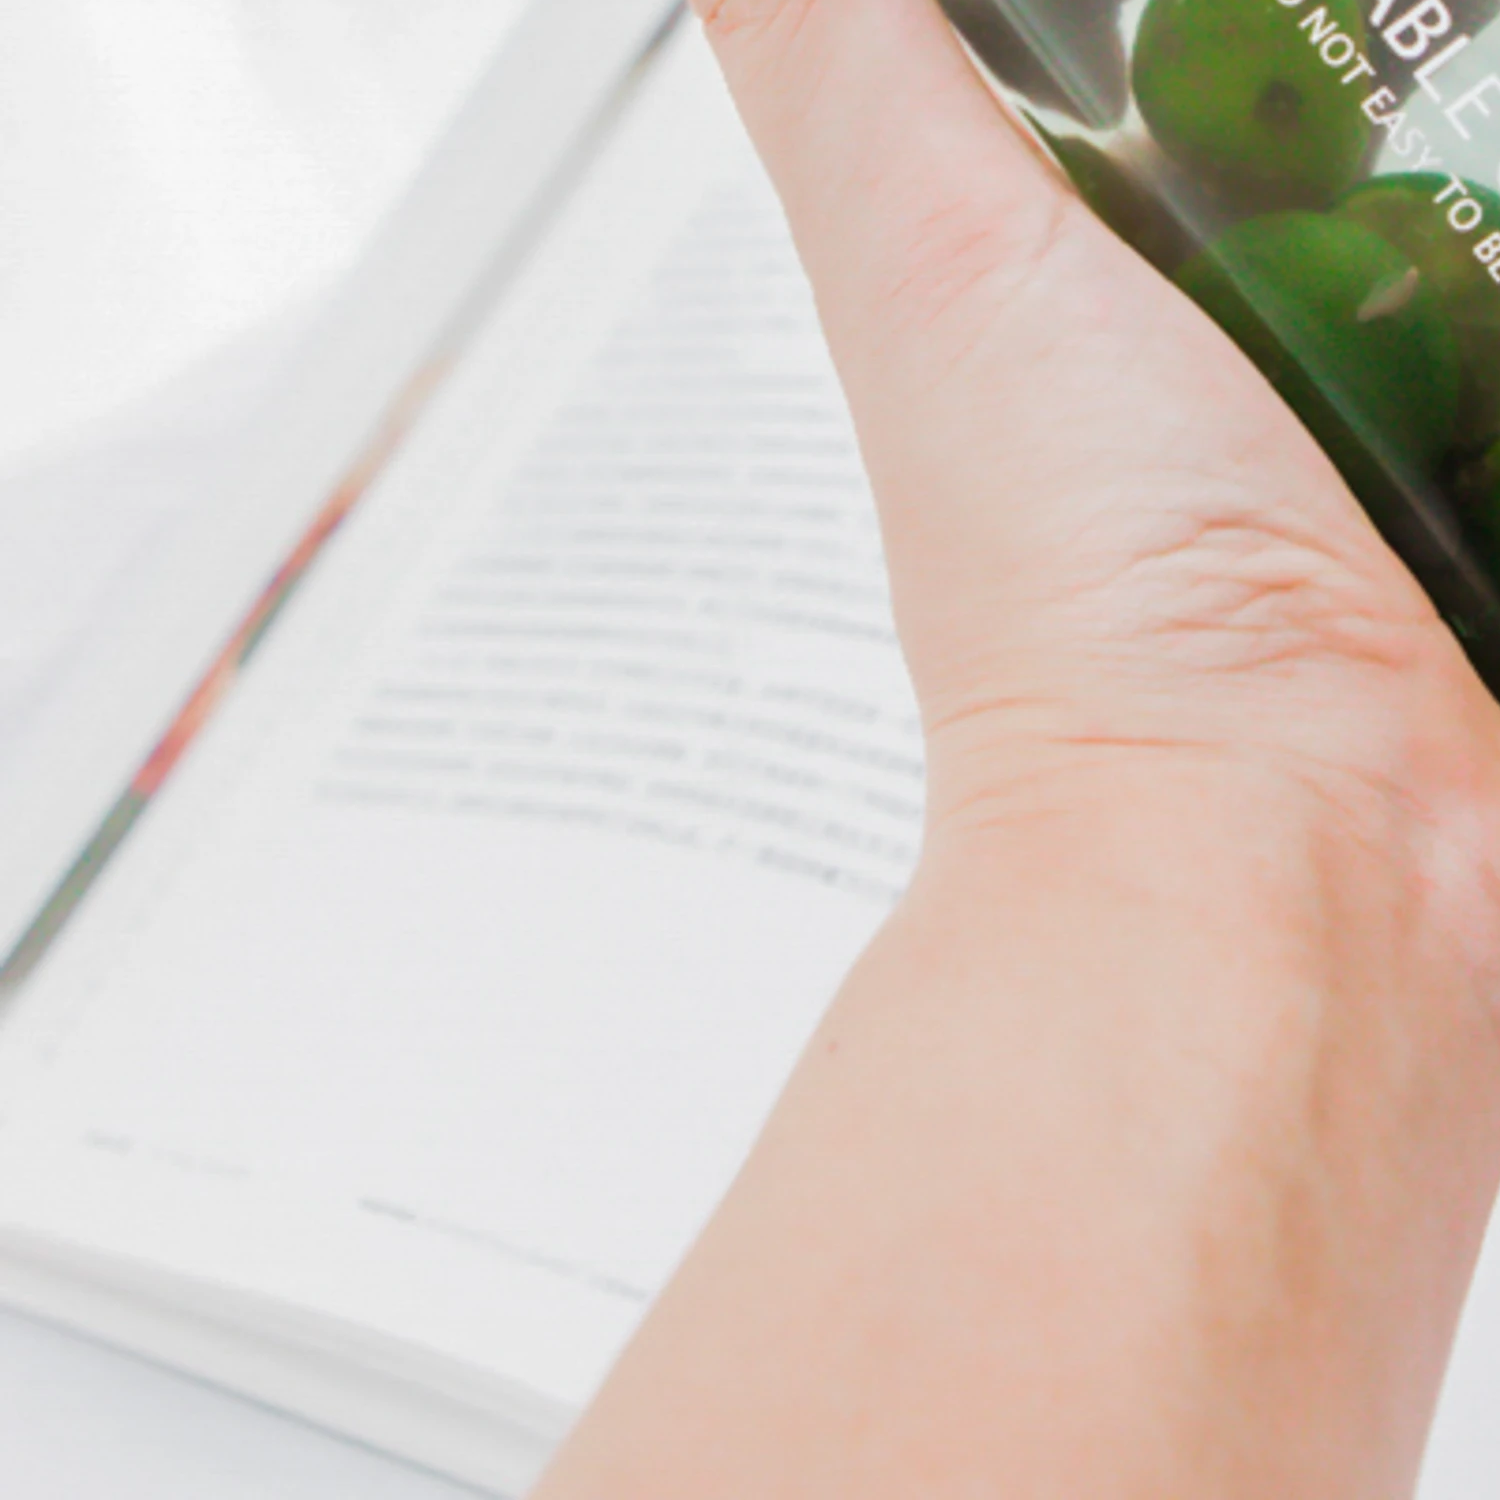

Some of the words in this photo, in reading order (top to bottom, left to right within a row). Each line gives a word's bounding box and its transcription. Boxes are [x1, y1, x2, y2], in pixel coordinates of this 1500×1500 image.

[1297, 7, 1376, 86] NOT
[1360, 85, 1444, 174] EASY
[1432, 175, 1484, 234] TO
